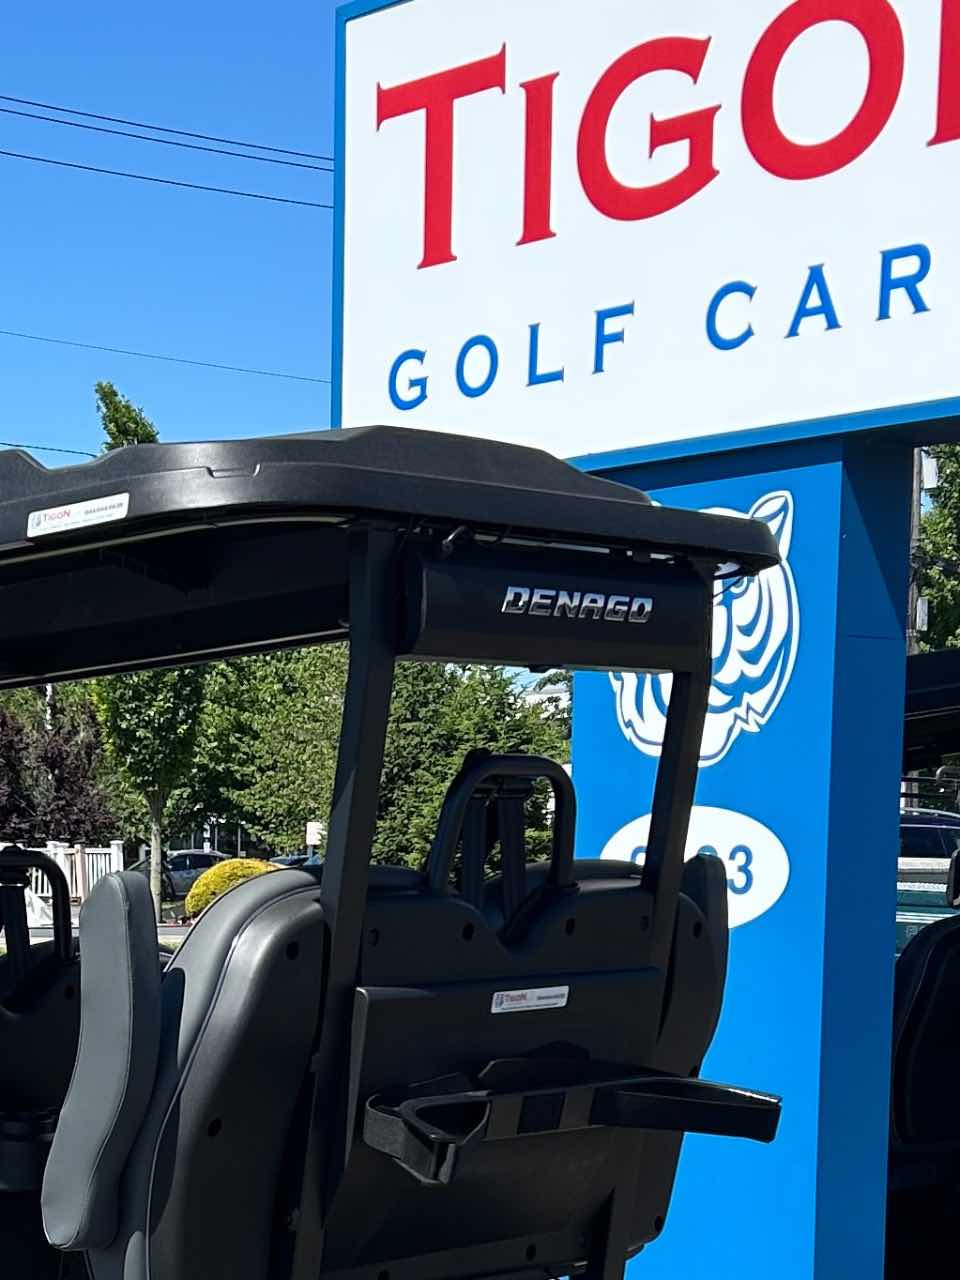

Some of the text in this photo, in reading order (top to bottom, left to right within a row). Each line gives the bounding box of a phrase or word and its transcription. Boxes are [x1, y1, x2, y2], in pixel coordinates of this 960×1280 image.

[376, 0, 960, 269] TIGO
[387, 300, 636, 412] GOLF
[501, 585, 654, 623] DENAGO
